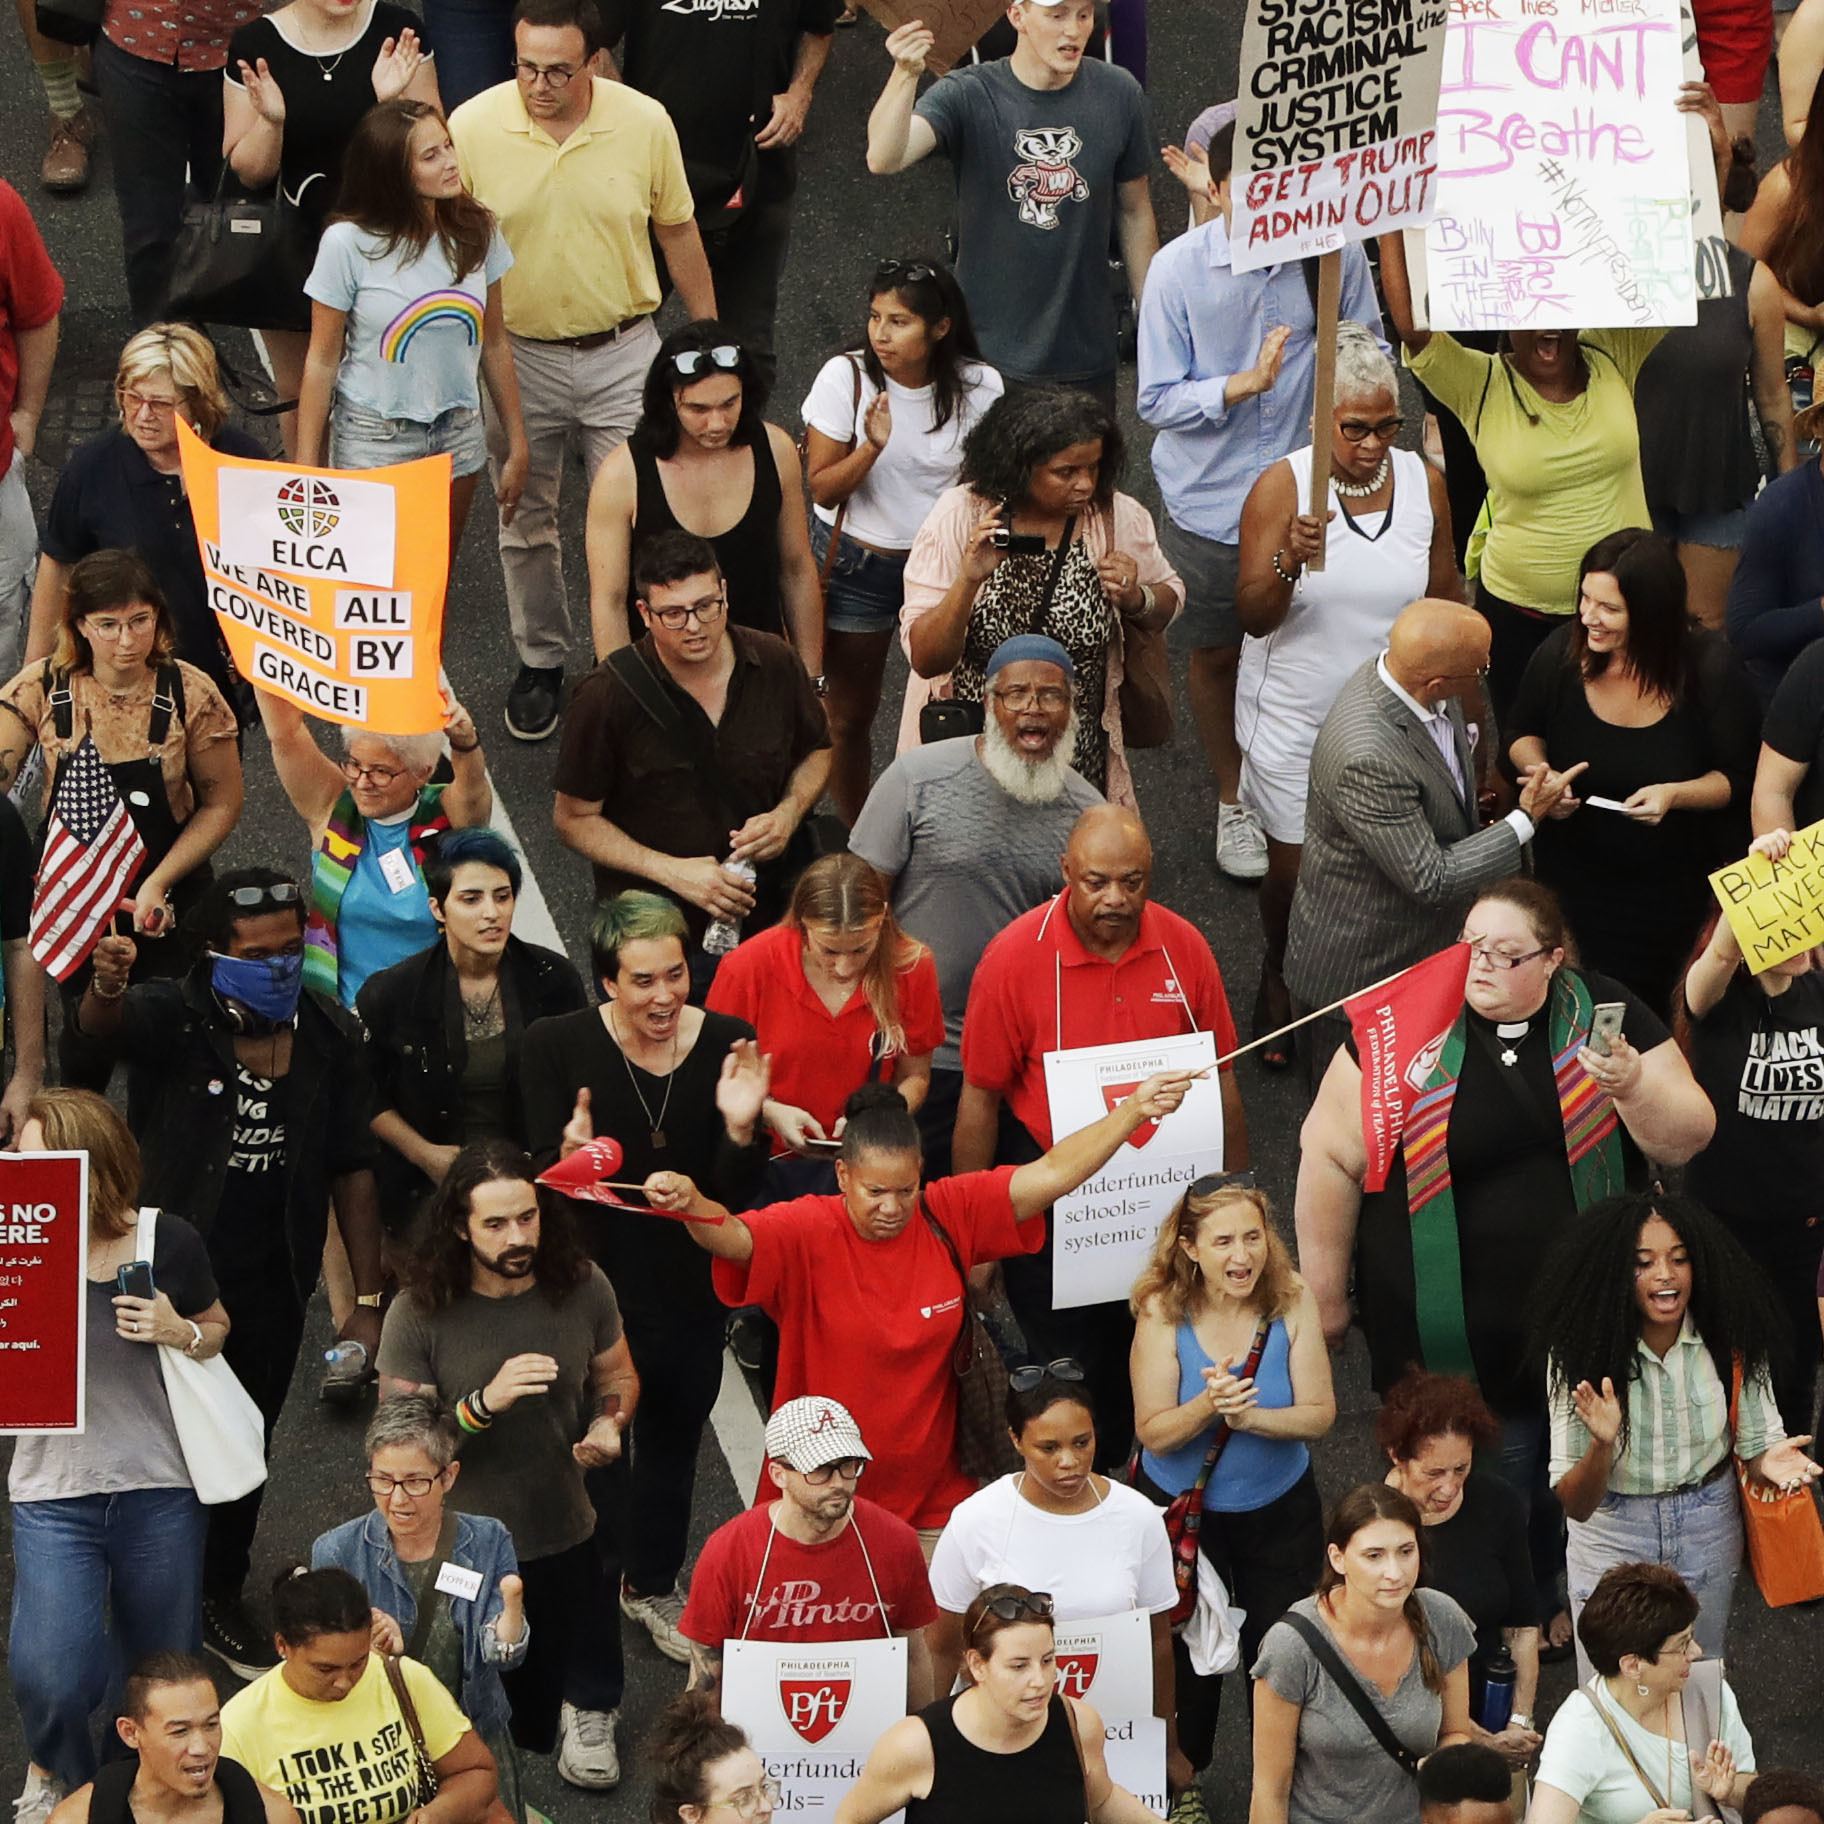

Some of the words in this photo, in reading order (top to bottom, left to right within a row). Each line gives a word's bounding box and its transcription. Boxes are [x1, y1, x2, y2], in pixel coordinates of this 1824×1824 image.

[1267, 0, 1415, 58] RACISM
[1416, 8, 1446, 33] the
[1250, 28, 1428, 96] CRIMINAL
[1513, 18, 1681, 100] CANT
[1245, 79, 1403, 140] JUSTICE
[1250, 105, 1399, 172] SYSTEM
[1247, 162, 1321, 212] GET
[1333, 130, 1438, 183] TRUMP
[1437, 106, 1656, 180] Breathe
[1247, 192, 1347, 250] ADMIN
[1354, 168, 1440, 226] OUT
[272, 537, 351, 576] ELCA
[256, 568, 311, 613] ARE
[344, 597, 408, 626] ALL
[212, 584, 337, 663] COVERED
[355, 638, 405, 672] BY
[258, 662, 367, 716] GRACE!
[1375, 1004, 1402, 1151] PHILADELPHIA
[11, 1203, 57, 1223] NO
[1064, 1199, 1152, 1225] schools=
[1064, 1226, 1148, 1253] systemic
[780, 1660, 853, 1673] PHILADELPHIA
[791, 1686, 844, 1730] pft
[279, 1758, 289, 1782] I
[292, 1743, 350, 1777] TOOK
[354, 1742, 368, 1763] A
[373, 1720, 402, 1757] STEP
[285, 1784, 309, 1806] IN
[319, 1770, 357, 1800] THE
[363, 1746, 411, 1793] RIGHT
